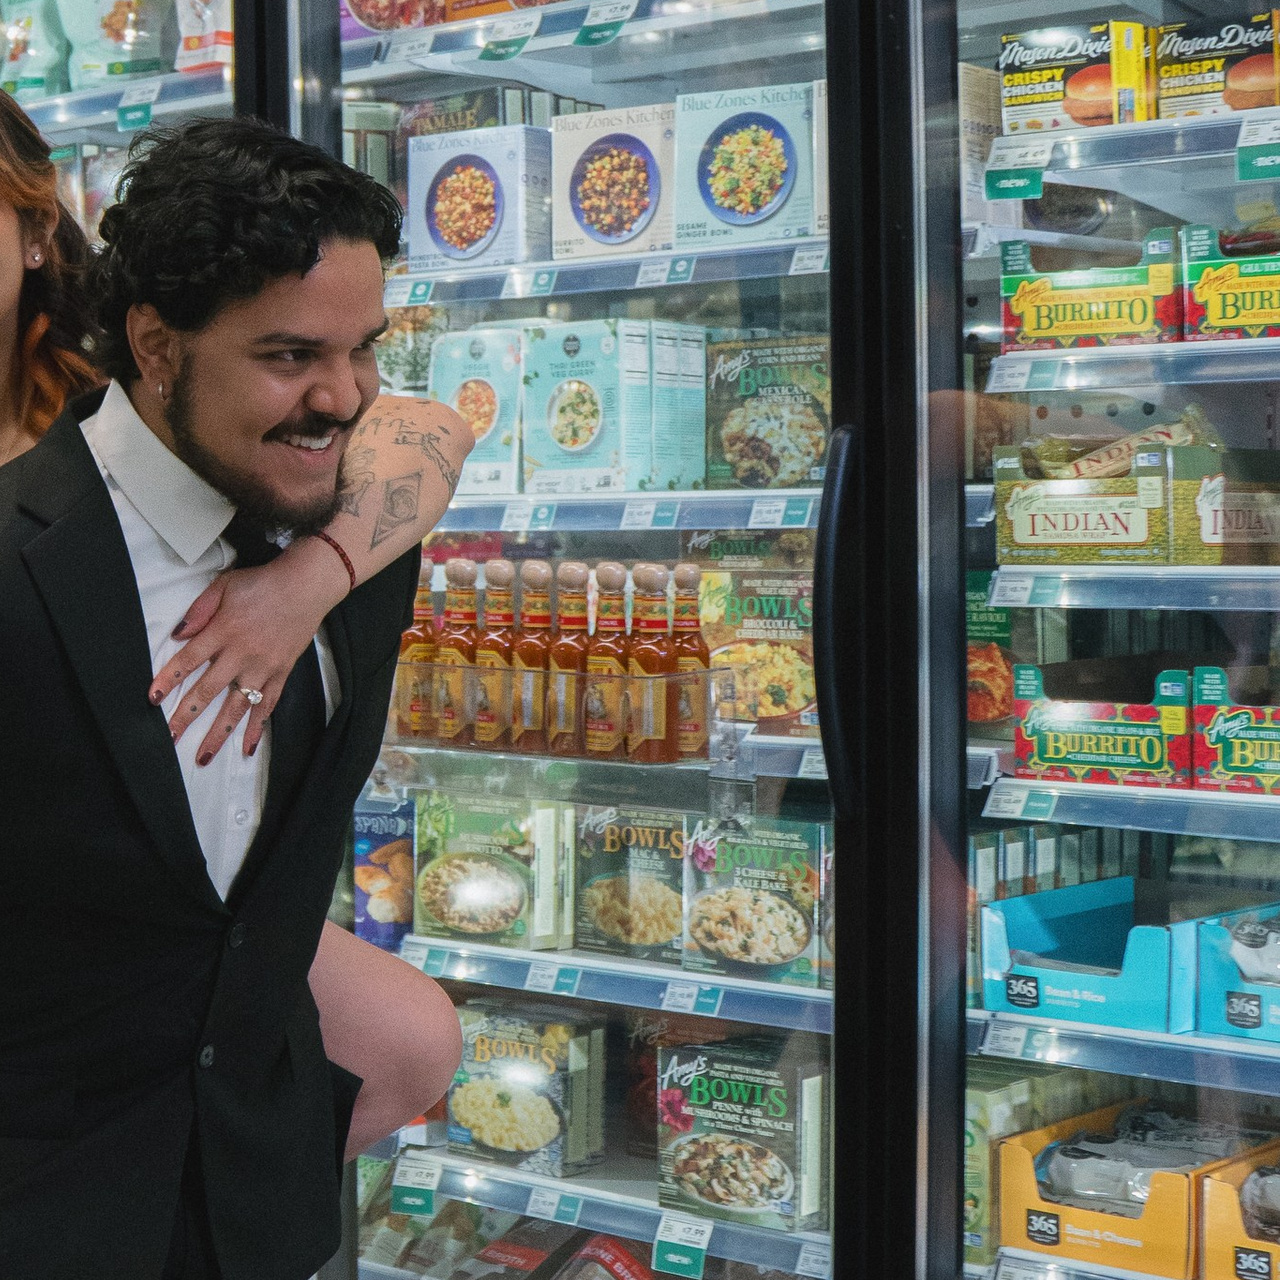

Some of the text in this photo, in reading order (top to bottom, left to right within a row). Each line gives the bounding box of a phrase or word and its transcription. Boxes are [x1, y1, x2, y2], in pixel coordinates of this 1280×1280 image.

[999, 41, 1058, 69] Mason
[1055, 34, 1112, 59] Dixie
[1156, 31, 1219, 60] Mason
[1217, 23, 1276, 48] Dixie
[1003, 67, 1066, 87] CRISPY
[1160, 57, 1226, 79] CRISPY
[1003, 80, 1064, 97] CHICKEN
[1160, 71, 1225, 88] CHICKEN
[681, 96, 711, 112] Blue
[715, 93, 756, 109] Zones
[760, 86, 813, 105] Kitchen
[554, 107, 675, 133] Blue Zones Kitchen
[675, 229, 733, 239] GINGER BOWL
[676, 222, 707, 231] SESAME
[1032, 297, 1149, 331] BURRITO
[570, 360, 596, 369] GREEN
[709, 349, 753, 390] Amy's
[738, 362, 827, 397] BOWLS
[758, 384, 807, 396] MEXICAN
[1027, 511, 1132, 537] INDIAN
[710, 539, 772, 560] BOWLS
[724, 594, 812, 627] BOWLS
[743, 619, 788, 629] BROCCOLI
[1208, 713, 1249, 743] Amy's
[1043, 731, 1162, 765] BURRITO
[580, 806, 618, 838] Amy's
[603, 824, 684, 859] BOWLS
[630, 847, 650, 858] MAC
[715, 842, 807, 881] BOWLS
[630, 857, 665, 870] CHEESE
[742, 867, 777, 880] CHEESE
[733, 879, 788, 892] KALE BAKE
[1008, 979, 1037, 998] 365
[1228, 997, 1259, 1017] 365
[474, 1034, 557, 1075] BOWLS
[661, 1055, 710, 1090] Amy's
[689, 1076, 788, 1118] BOWLS
[681, 1106, 794, 1132] MUSHROOMS & SPINACH
[712, 1101, 763, 1117] PENNE with
[682, 1226, 706, 1237] $7.99
[1028, 1215, 1057, 1235] 365
[1236, 1253, 1269, 1274] 365
